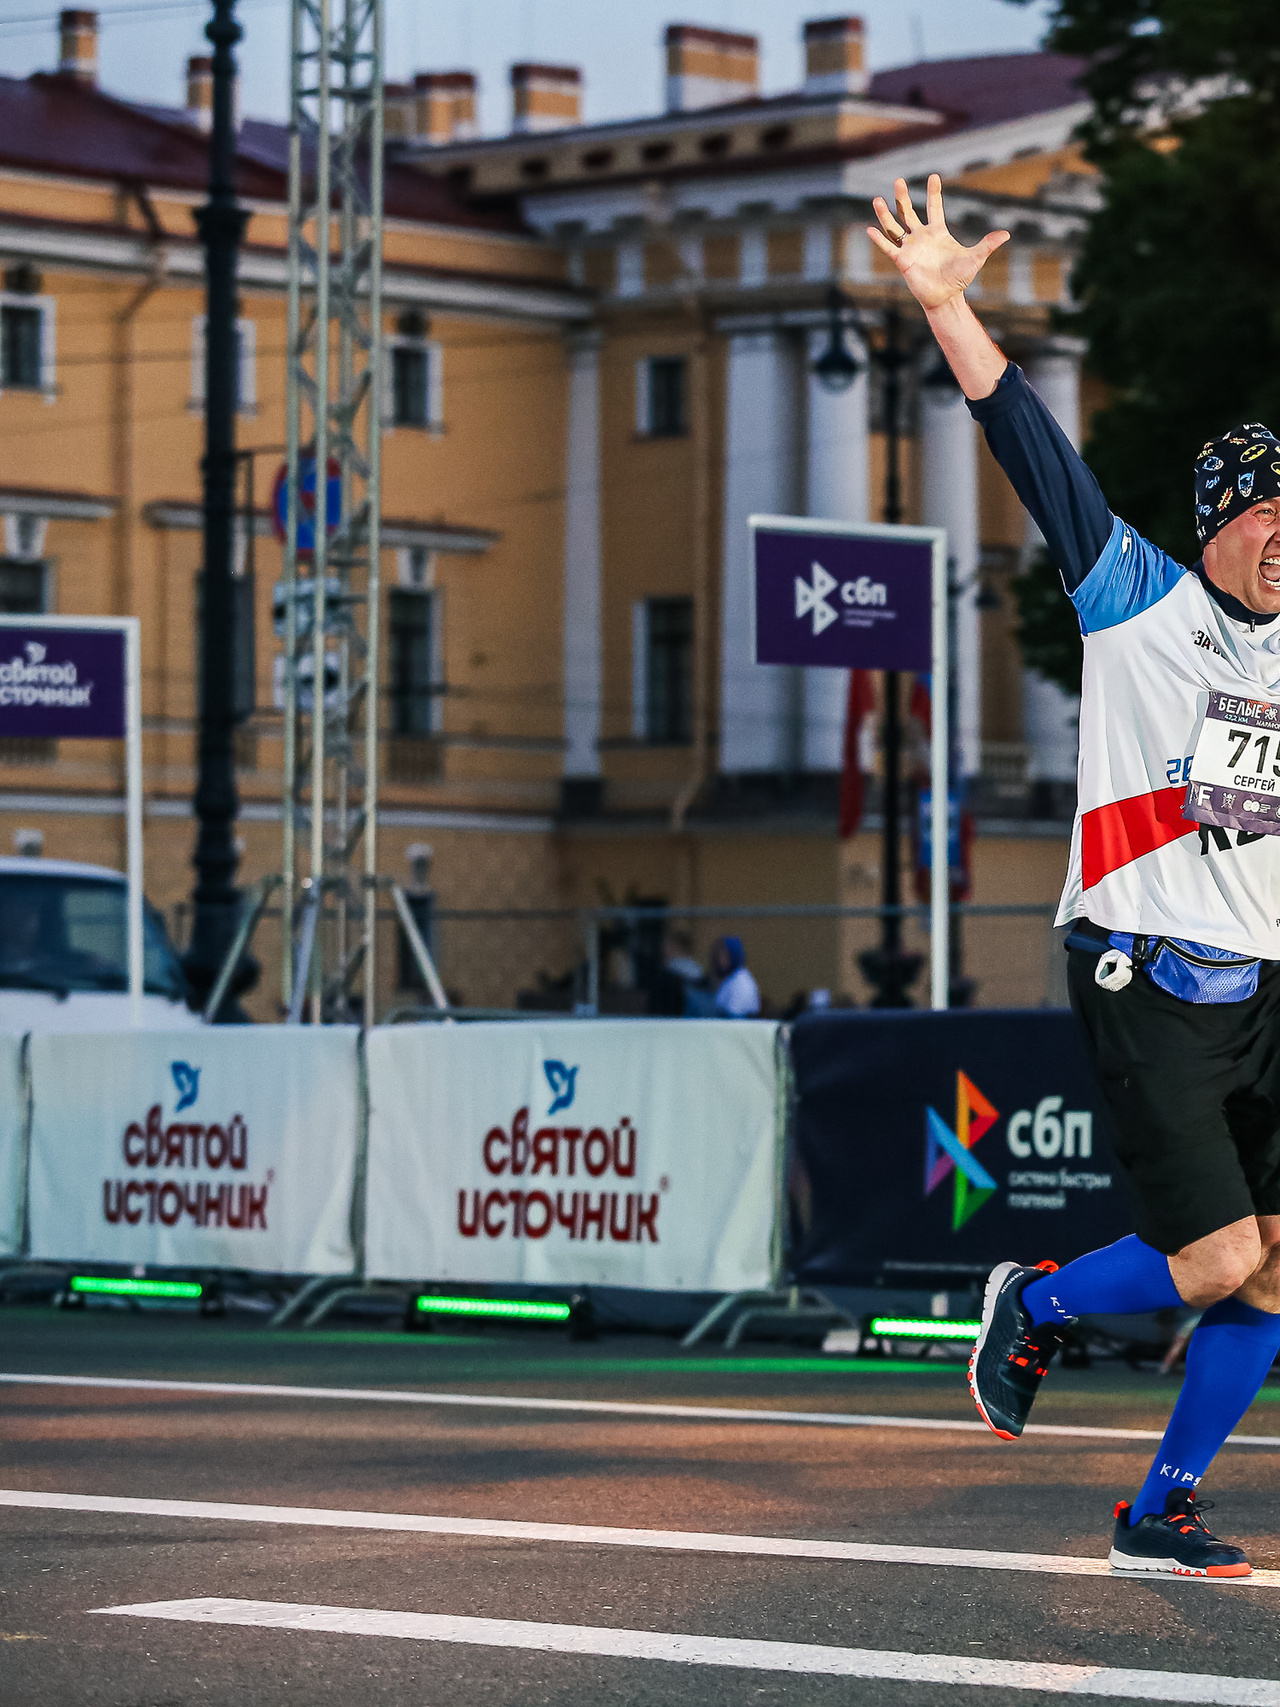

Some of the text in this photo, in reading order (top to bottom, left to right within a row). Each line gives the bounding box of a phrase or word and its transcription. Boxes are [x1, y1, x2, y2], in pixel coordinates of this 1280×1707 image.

[840, 575, 888, 607] сбп
[1218, 697, 1264, 719] БЕЛЫЕ
[1234, 774, 1276, 792] СЕРГЕЙ
[1006, 1095, 1093, 1159] сбп
